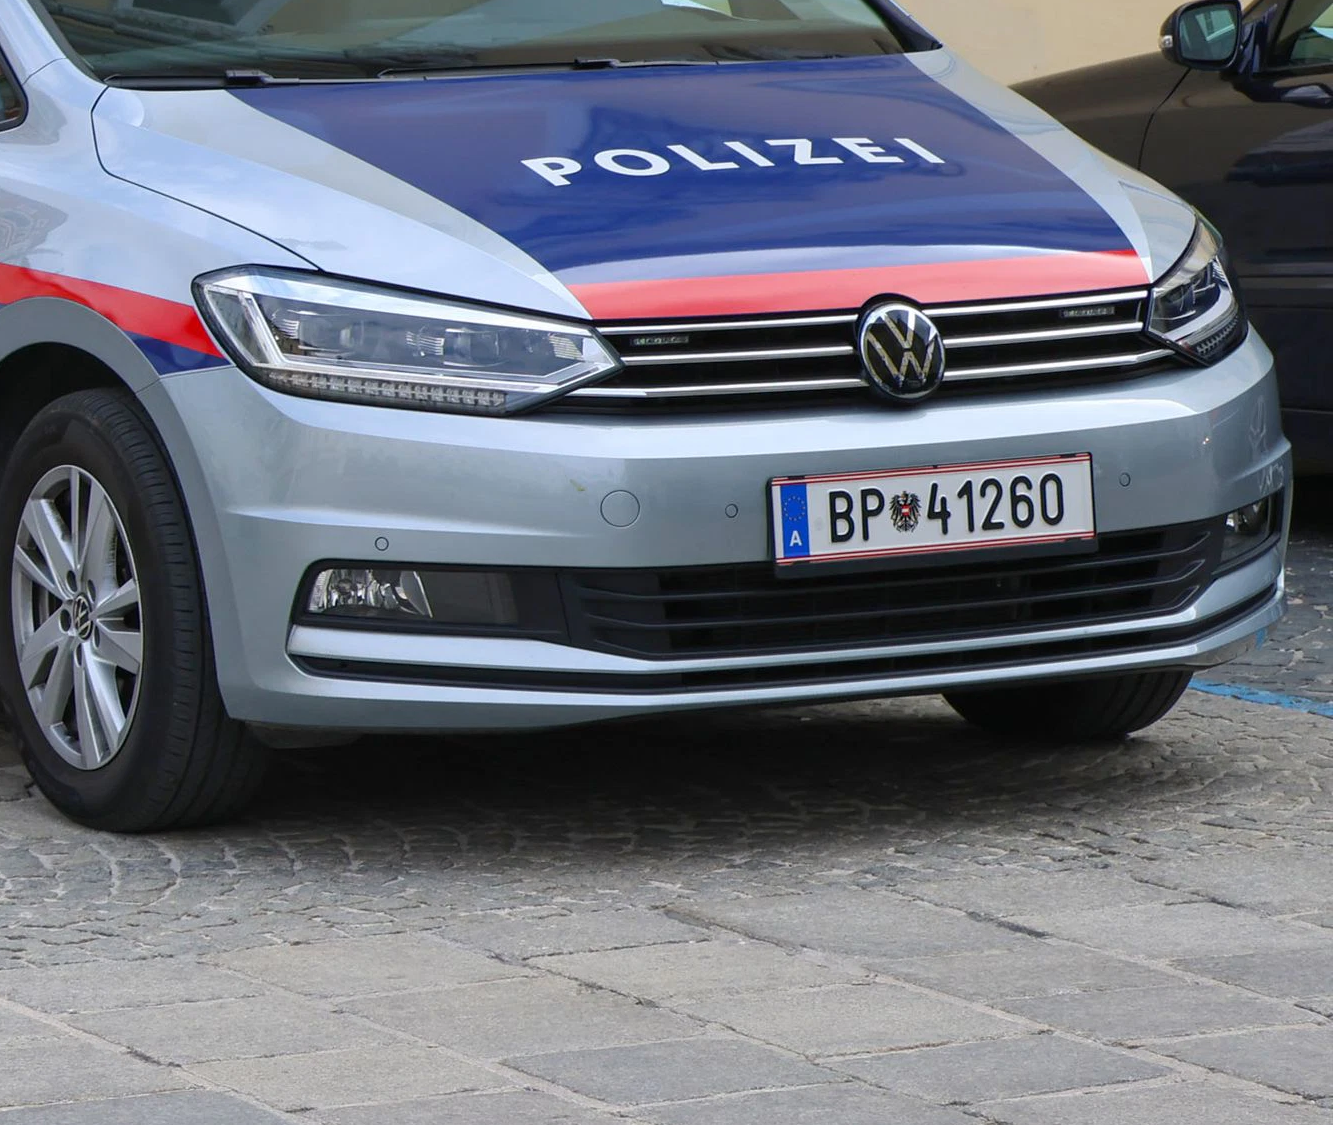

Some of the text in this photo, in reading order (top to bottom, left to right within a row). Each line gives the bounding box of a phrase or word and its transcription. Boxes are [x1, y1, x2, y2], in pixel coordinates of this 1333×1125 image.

[520, 137, 946, 187] POLIZEI
[829, 472, 1065, 543] BP 41260
[789, 530, 803, 547] A
